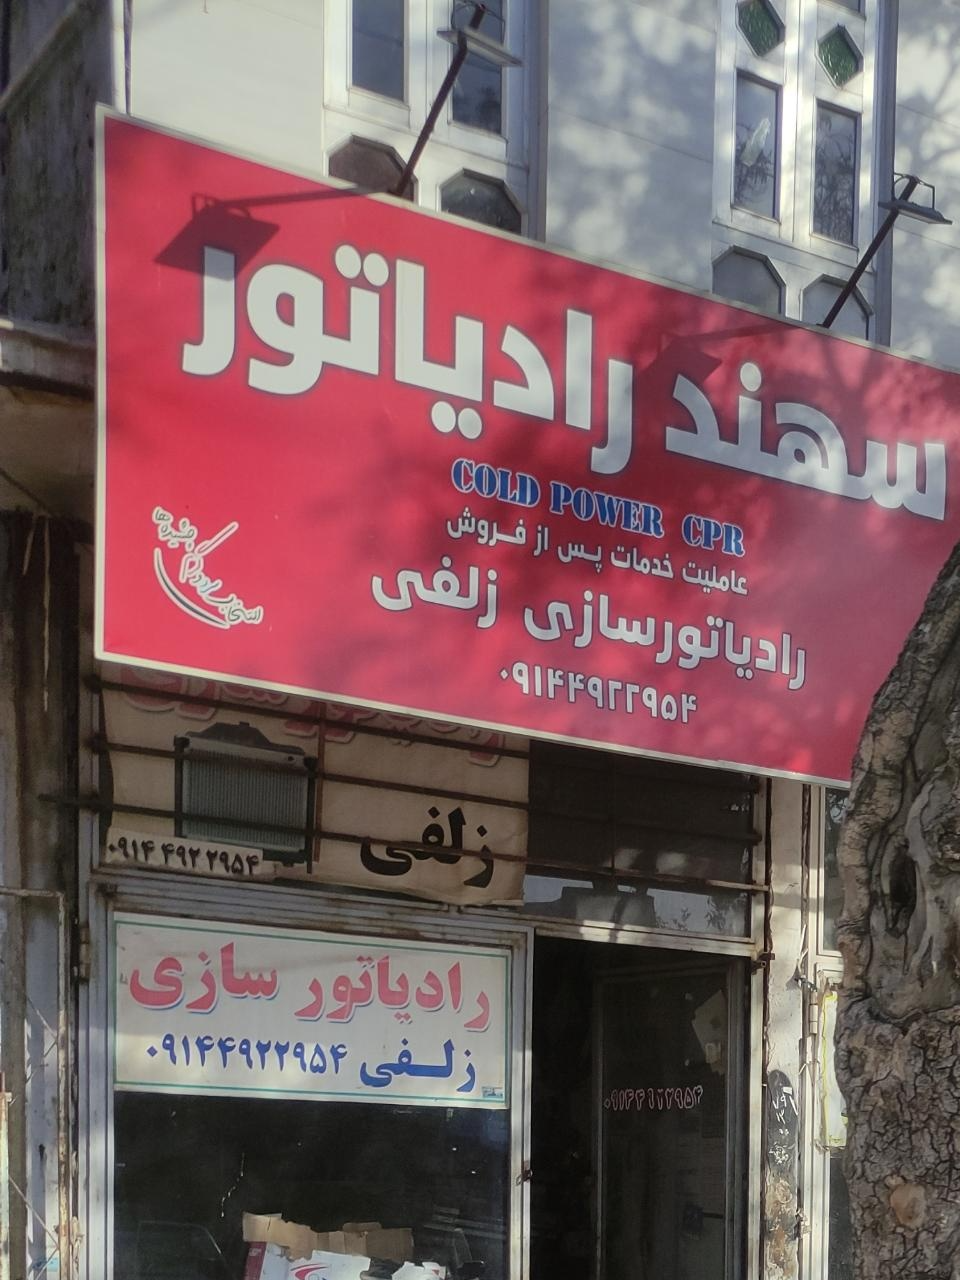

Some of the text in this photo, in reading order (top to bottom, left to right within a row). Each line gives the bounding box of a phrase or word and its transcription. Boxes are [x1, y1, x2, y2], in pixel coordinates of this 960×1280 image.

[181, 244, 948, 521] سهند رادیاتور
[447, 506, 749, 595] عاملیت خدمات پس از فروش
[452, 458, 746, 557] COLD POWER CPR
[371, 556, 499, 629] زلفی
[499, 661, 698, 724] ۰۹۱۴۴۹۲۲۹۵۴
[359, 805, 495, 888] زلفی
[129, 942, 493, 1032] رادیاتور سازی
[146, 1032, 477, 1094] زلفی ۰۹۱۴۴۹۲۲۹۵۴
